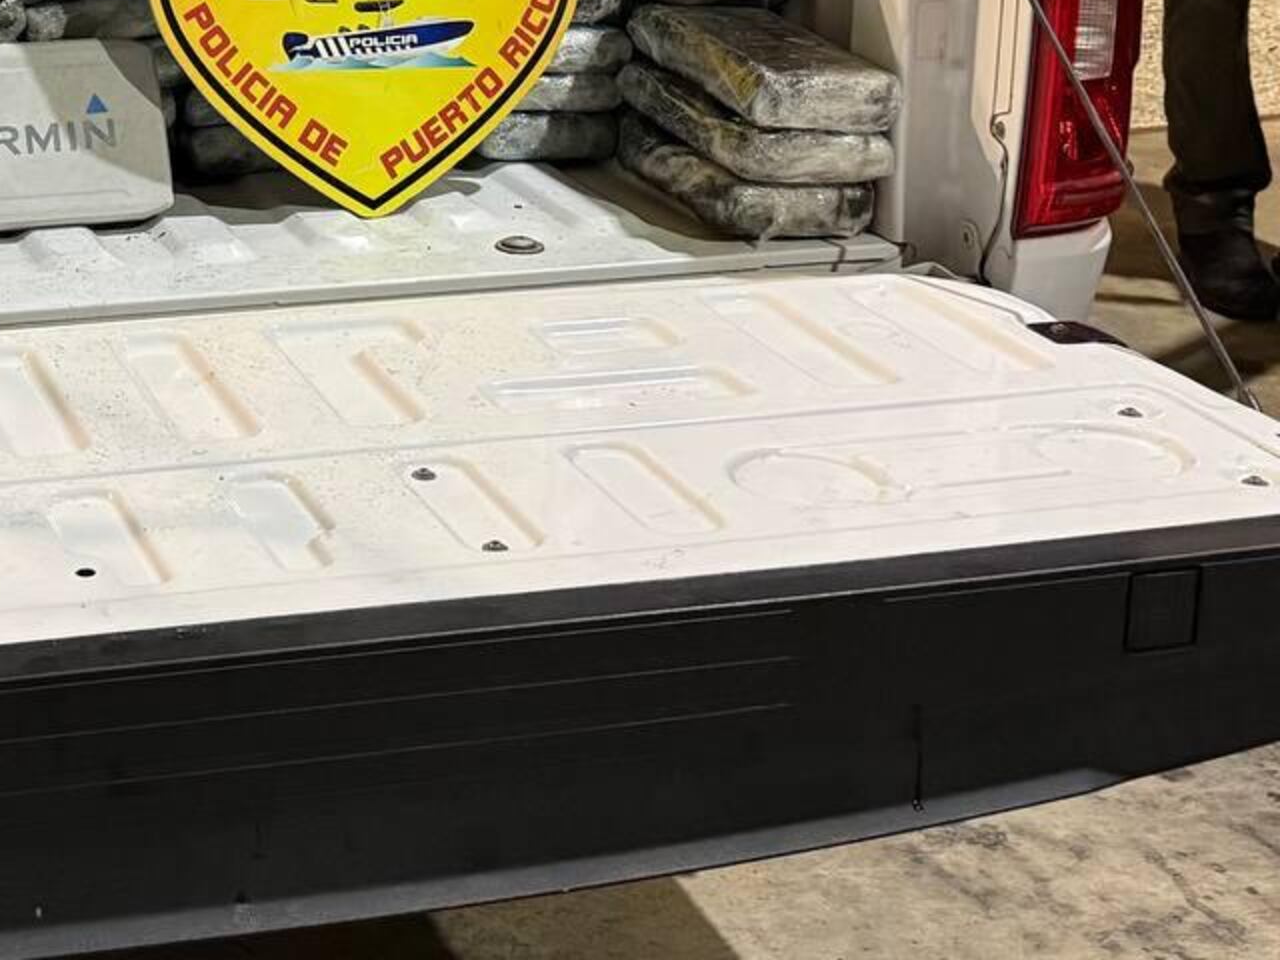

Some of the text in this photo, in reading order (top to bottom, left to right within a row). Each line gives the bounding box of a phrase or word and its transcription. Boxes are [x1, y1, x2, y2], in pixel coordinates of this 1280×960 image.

[349, 33, 418, 47] POLICIA
[183, 1, 298, 130] POLICIA
[297, 117, 349, 168] DE
[378, 66, 504, 180] PUERTO
